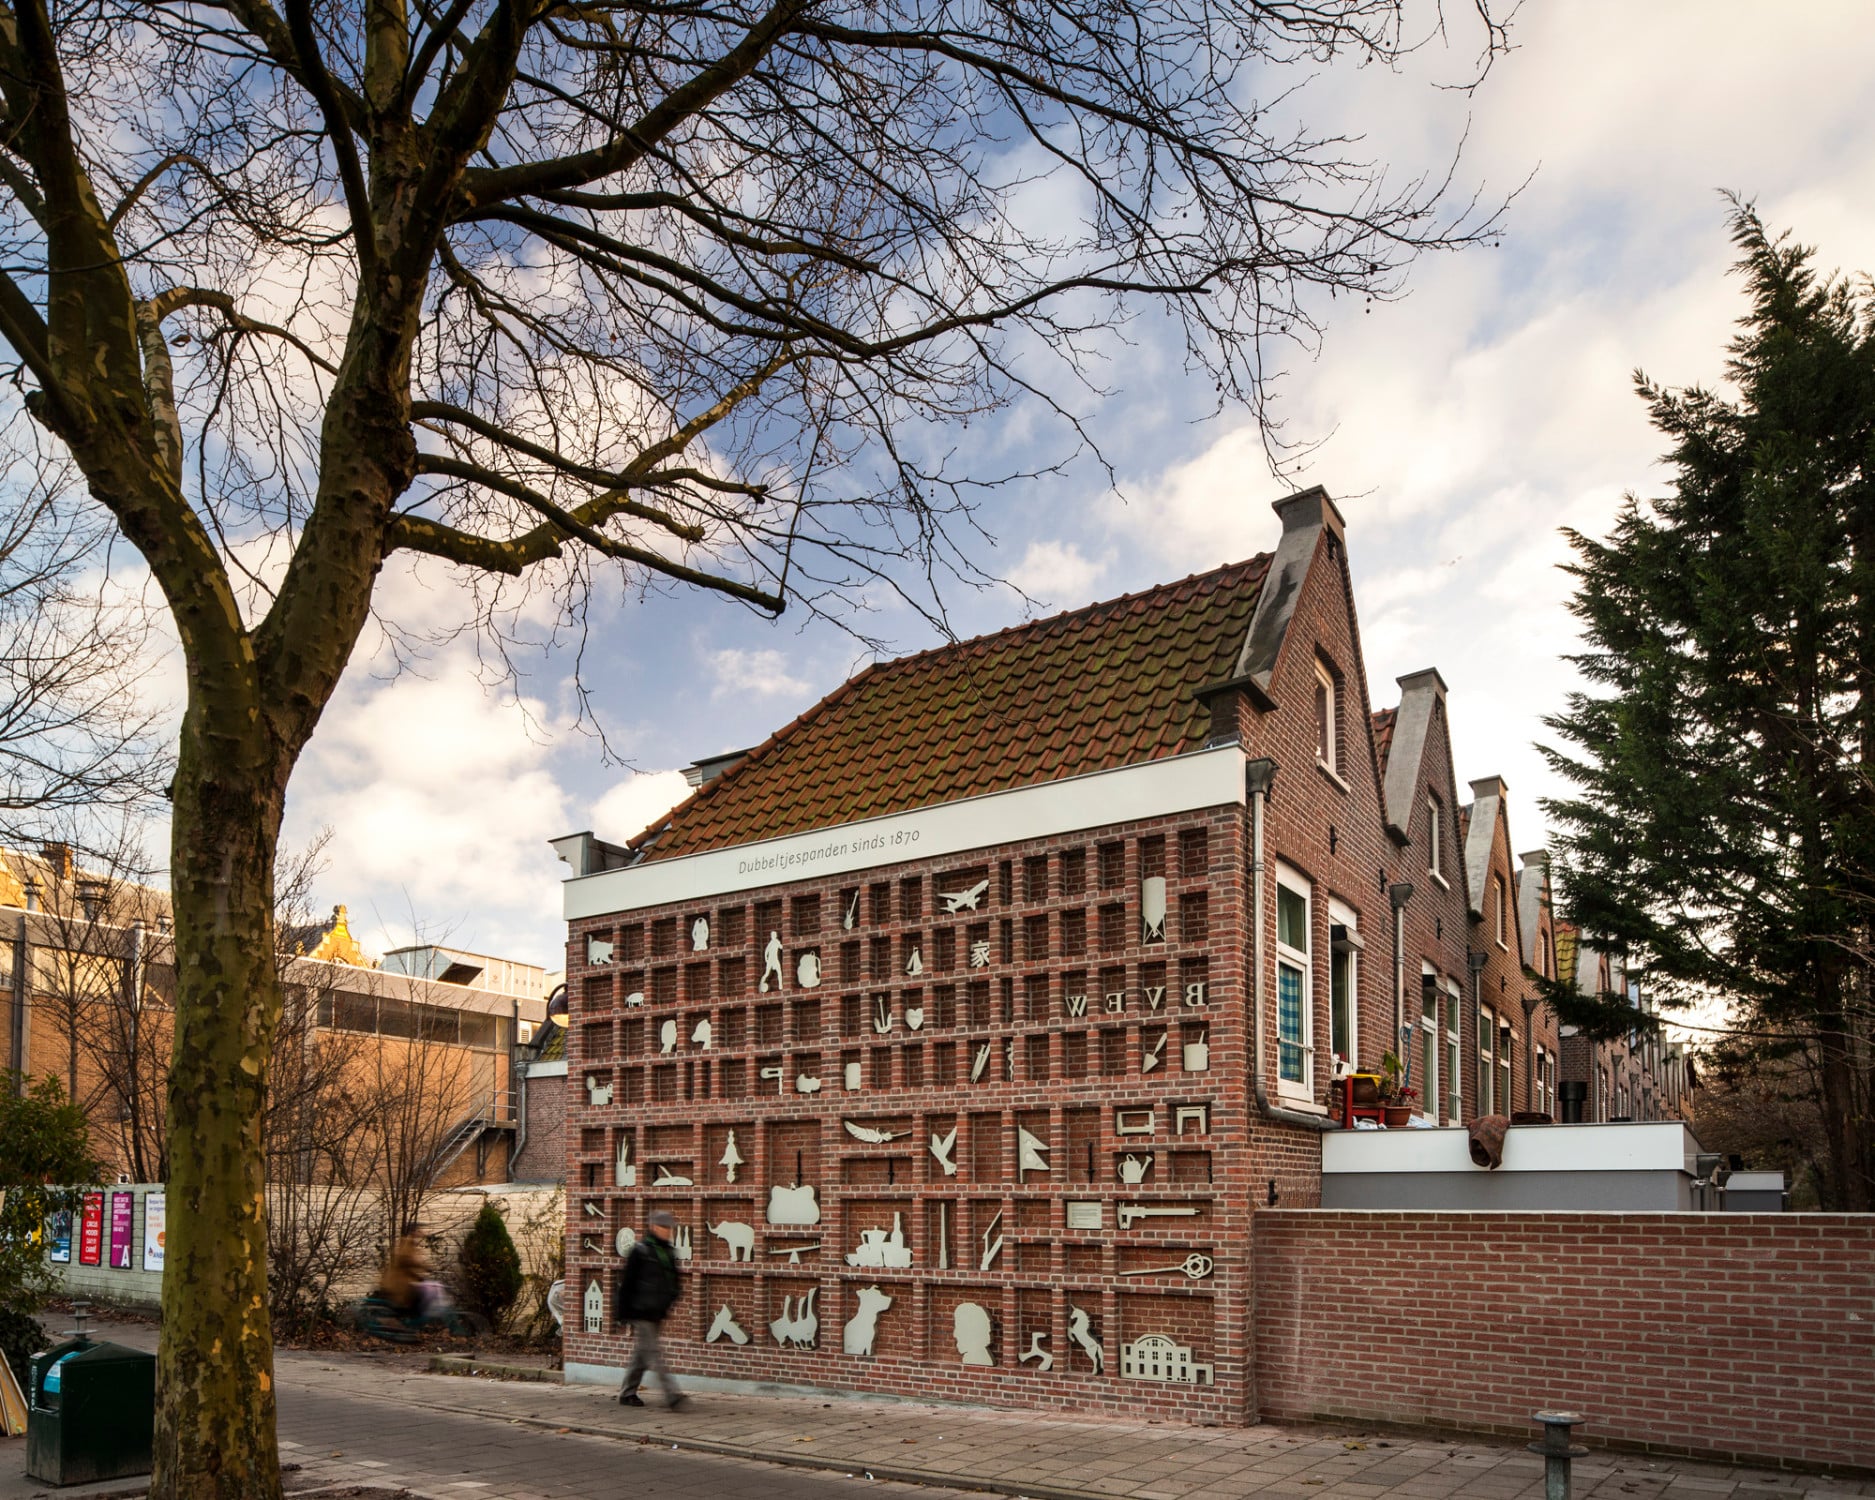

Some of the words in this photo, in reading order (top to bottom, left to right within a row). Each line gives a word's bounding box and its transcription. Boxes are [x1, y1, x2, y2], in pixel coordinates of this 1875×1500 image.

[738, 843, 848, 874] Dubbeltjespanden
[851, 834, 885, 853] sinds
[889, 830, 920, 846] 1870
